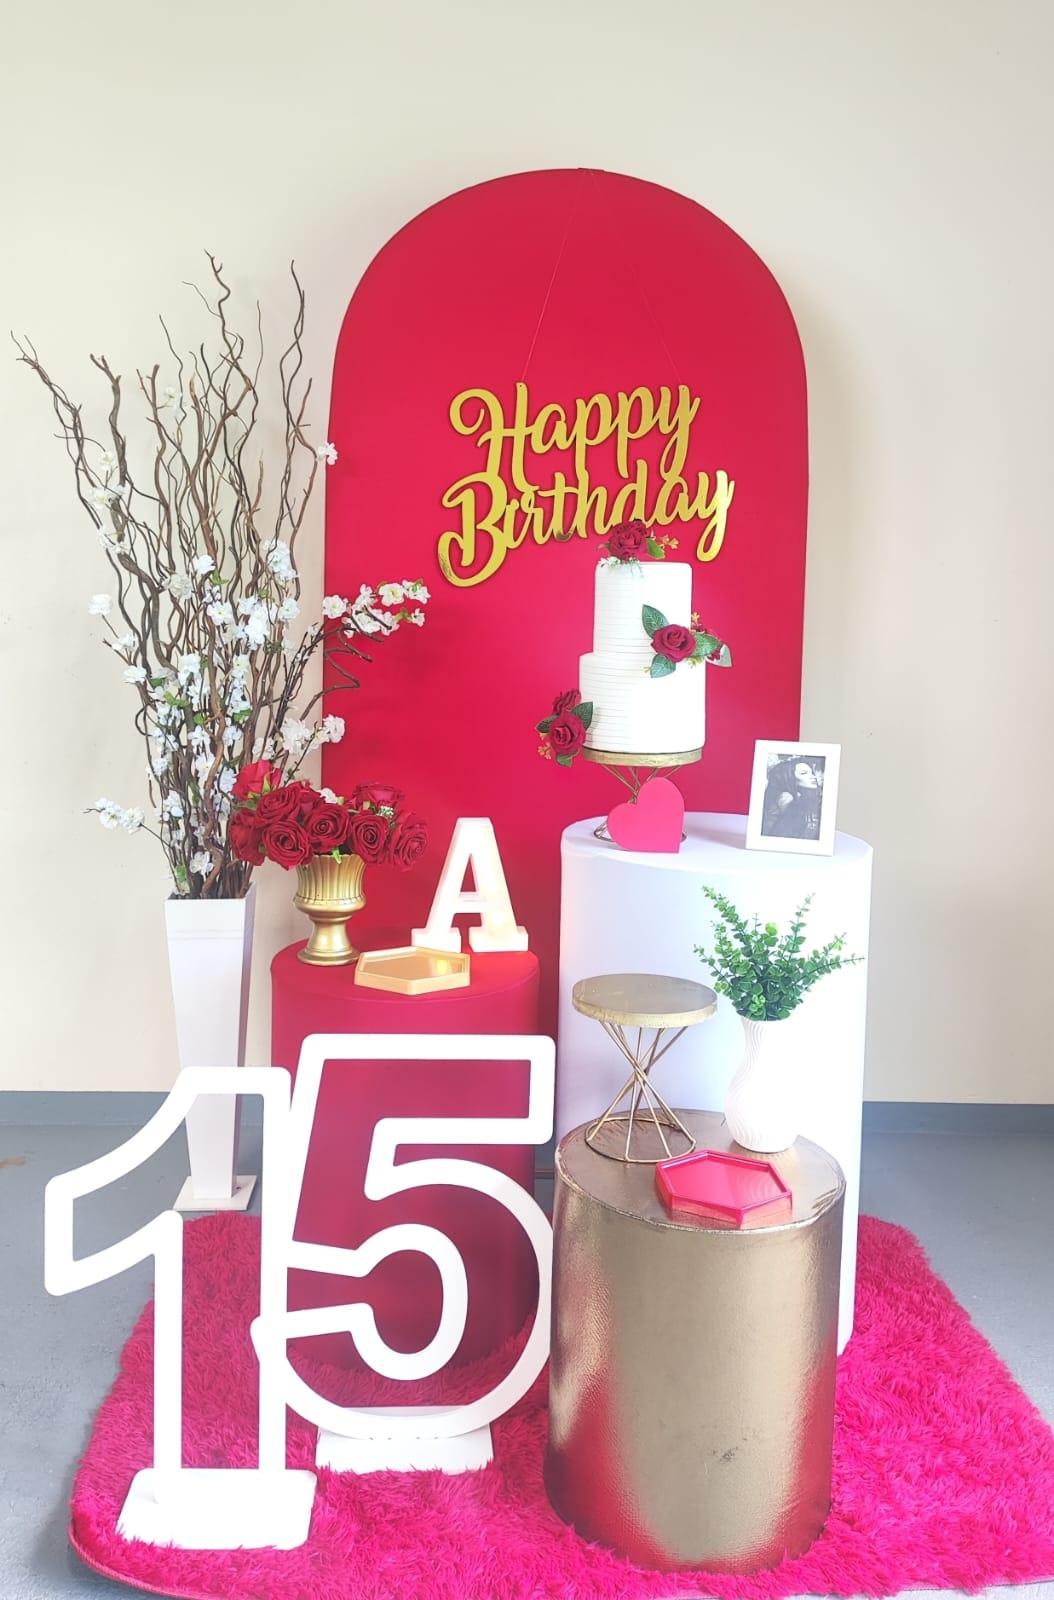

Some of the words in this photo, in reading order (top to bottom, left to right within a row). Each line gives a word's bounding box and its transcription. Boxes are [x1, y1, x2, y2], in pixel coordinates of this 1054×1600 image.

[449, 382, 700, 492] Happy
[438, 459, 735, 587] Birthday
[411, 817, 529, 953] A
[44, 1033, 556, 1505] 15
